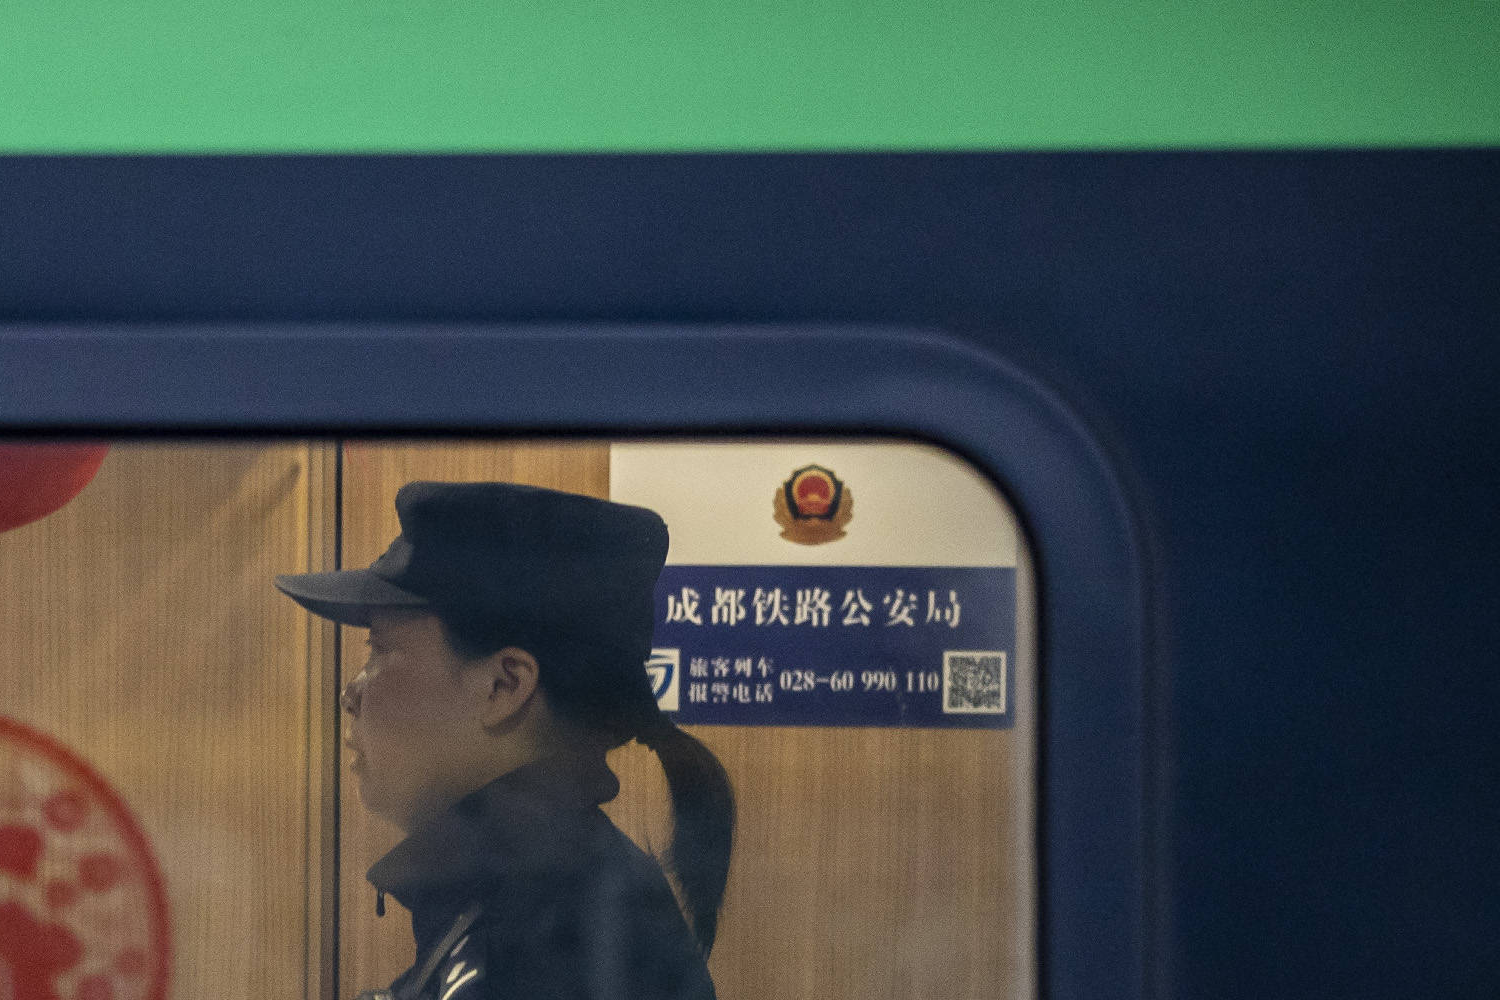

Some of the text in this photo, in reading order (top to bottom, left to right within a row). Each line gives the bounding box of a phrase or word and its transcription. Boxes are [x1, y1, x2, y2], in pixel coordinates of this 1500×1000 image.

[665, 587, 961, 627] 成都铁路公安局
[689, 656, 774, 678] 旅客列车
[779, 670, 939, 692] 028-60 990 110
[688, 683, 774, 704] 报警电话
